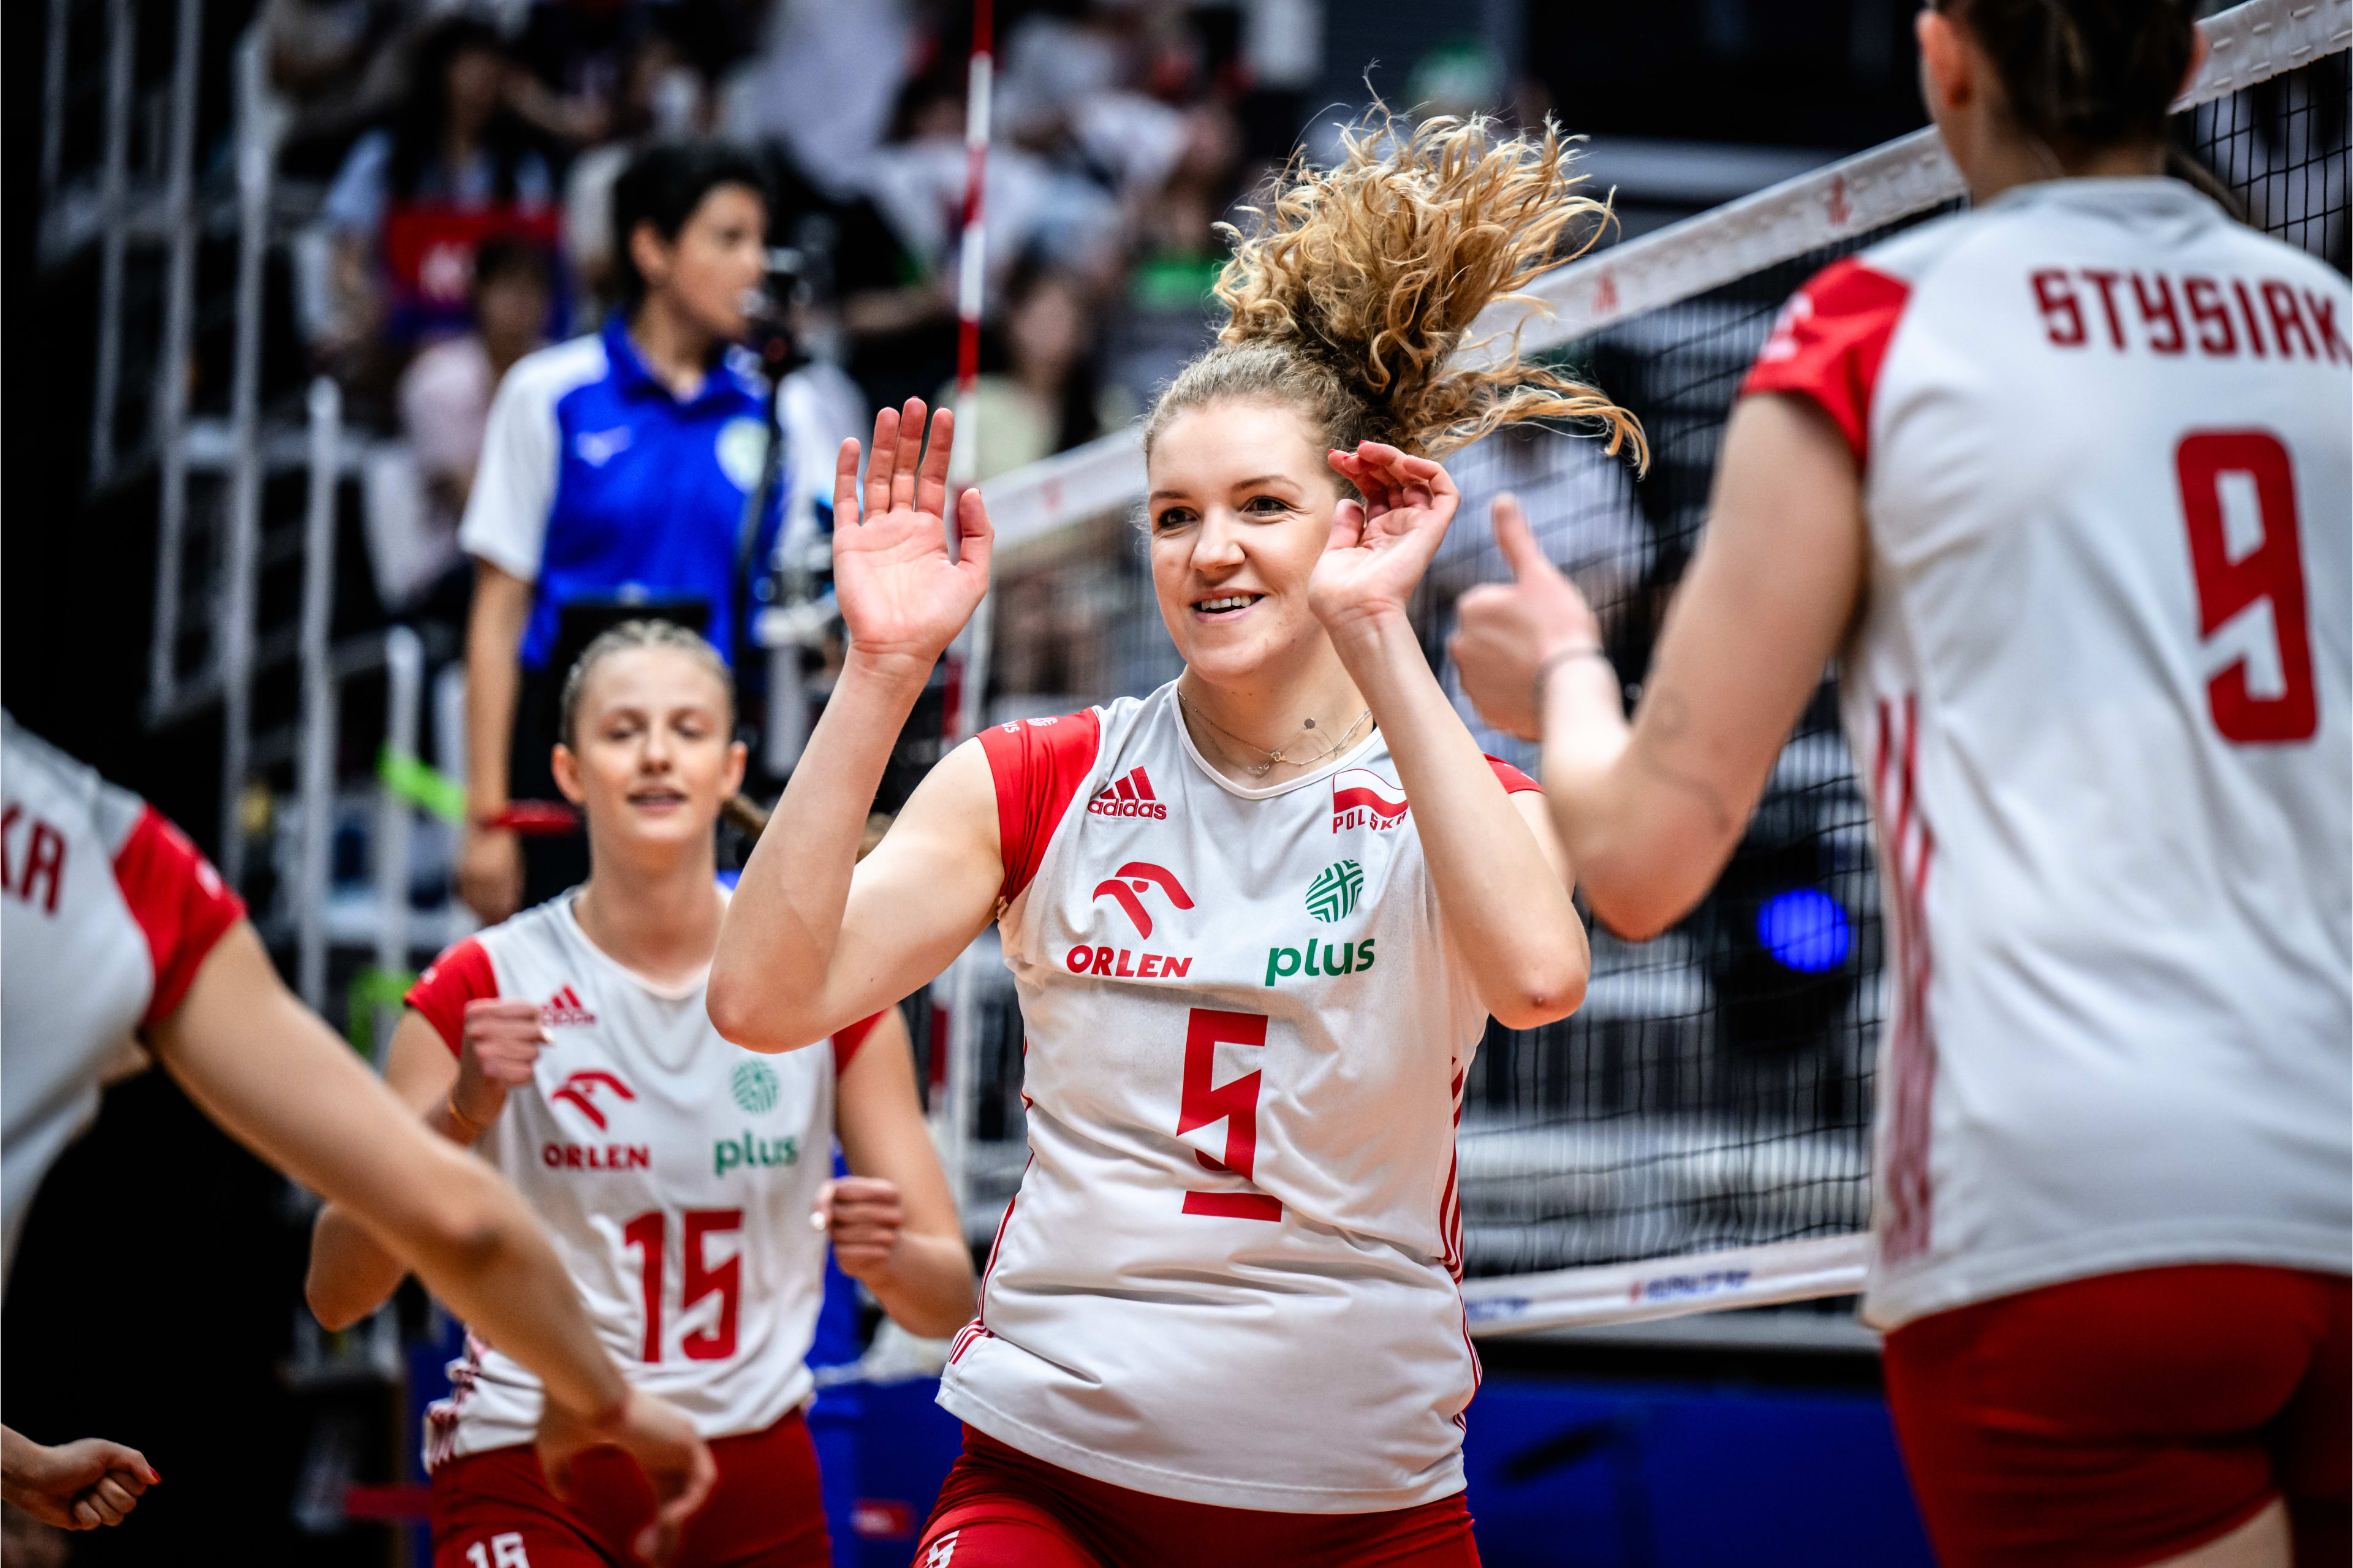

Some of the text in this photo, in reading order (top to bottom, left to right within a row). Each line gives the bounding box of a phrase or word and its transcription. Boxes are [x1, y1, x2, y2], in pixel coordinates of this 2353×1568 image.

[2029, 268, 2352, 370] STYSIAK
[2175, 425, 2319, 744] 9
[1087, 798, 1167, 820] adidas
[1333, 809, 1407, 834] POLSKA
[1066, 944, 1192, 977] ORLEN
[1265, 937, 1375, 987] plus
[1176, 1008, 1283, 1222] 5
[544, 1143, 650, 1170] ORLEN
[713, 1129, 798, 1176] plus
[623, 1208, 744, 1363] 15
